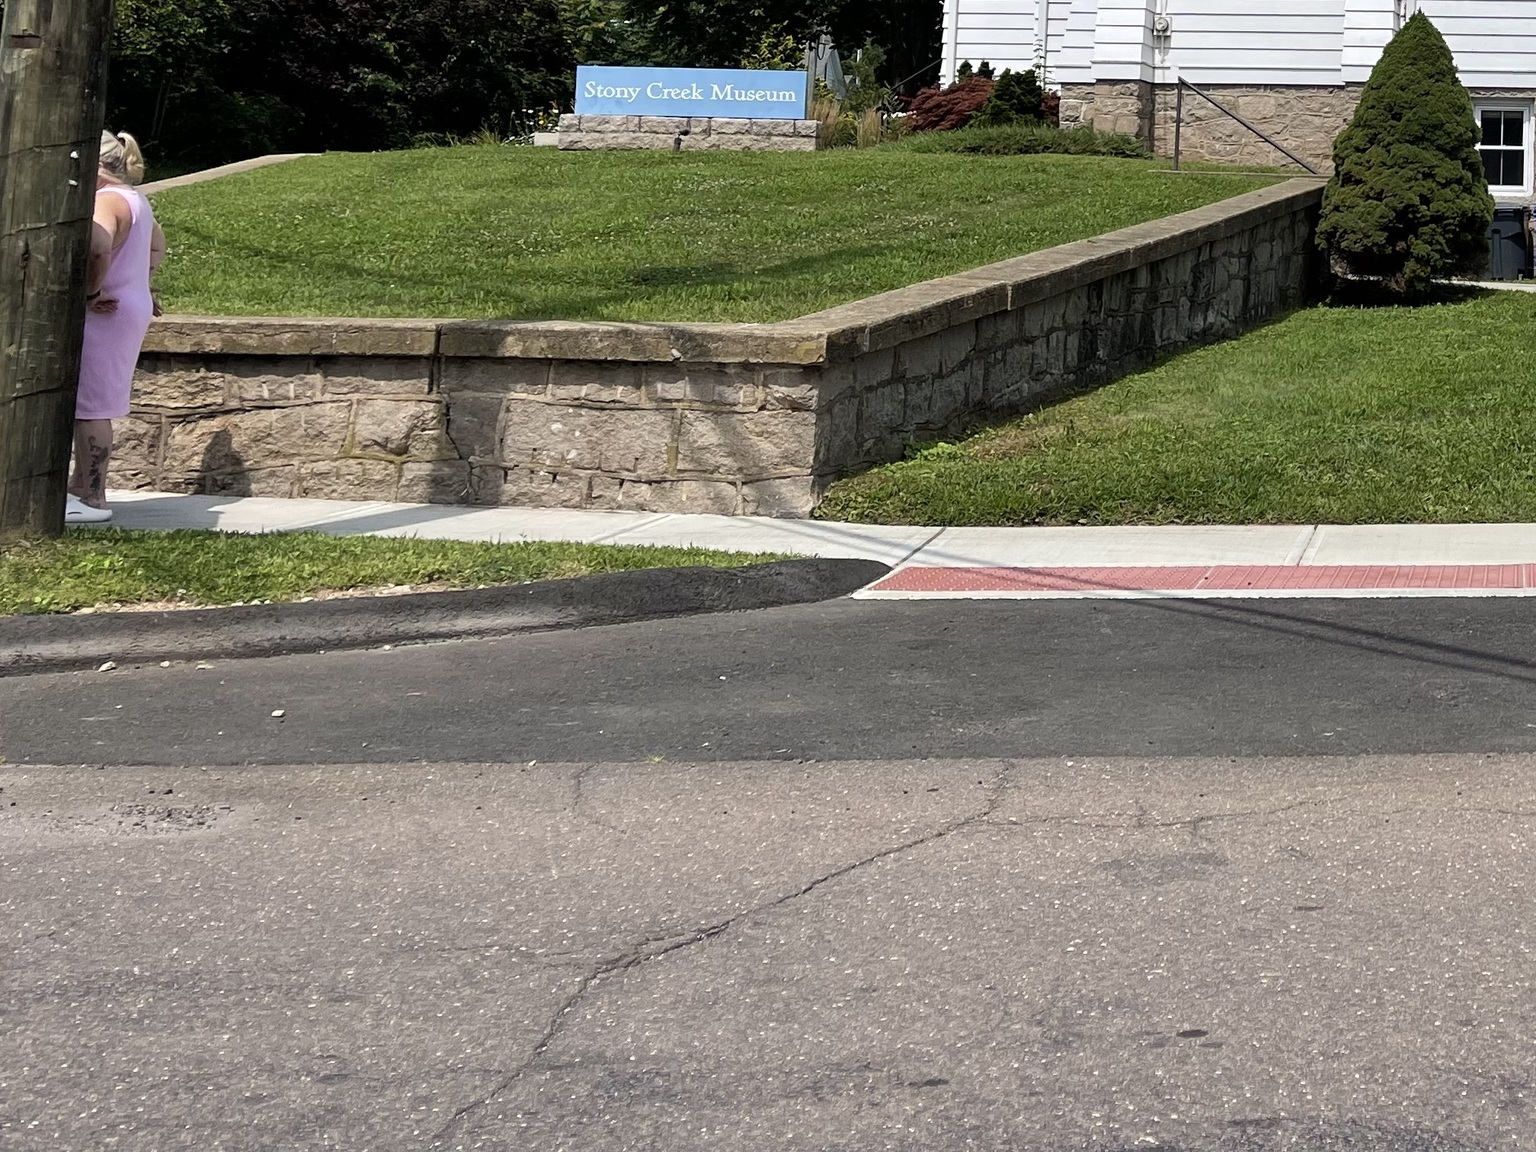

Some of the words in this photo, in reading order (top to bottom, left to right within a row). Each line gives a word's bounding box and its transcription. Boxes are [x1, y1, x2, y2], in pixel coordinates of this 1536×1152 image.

[584, 81, 641, 103] Stony
[646, 81, 704, 100] Creek
[710, 83, 797, 102] Museum
